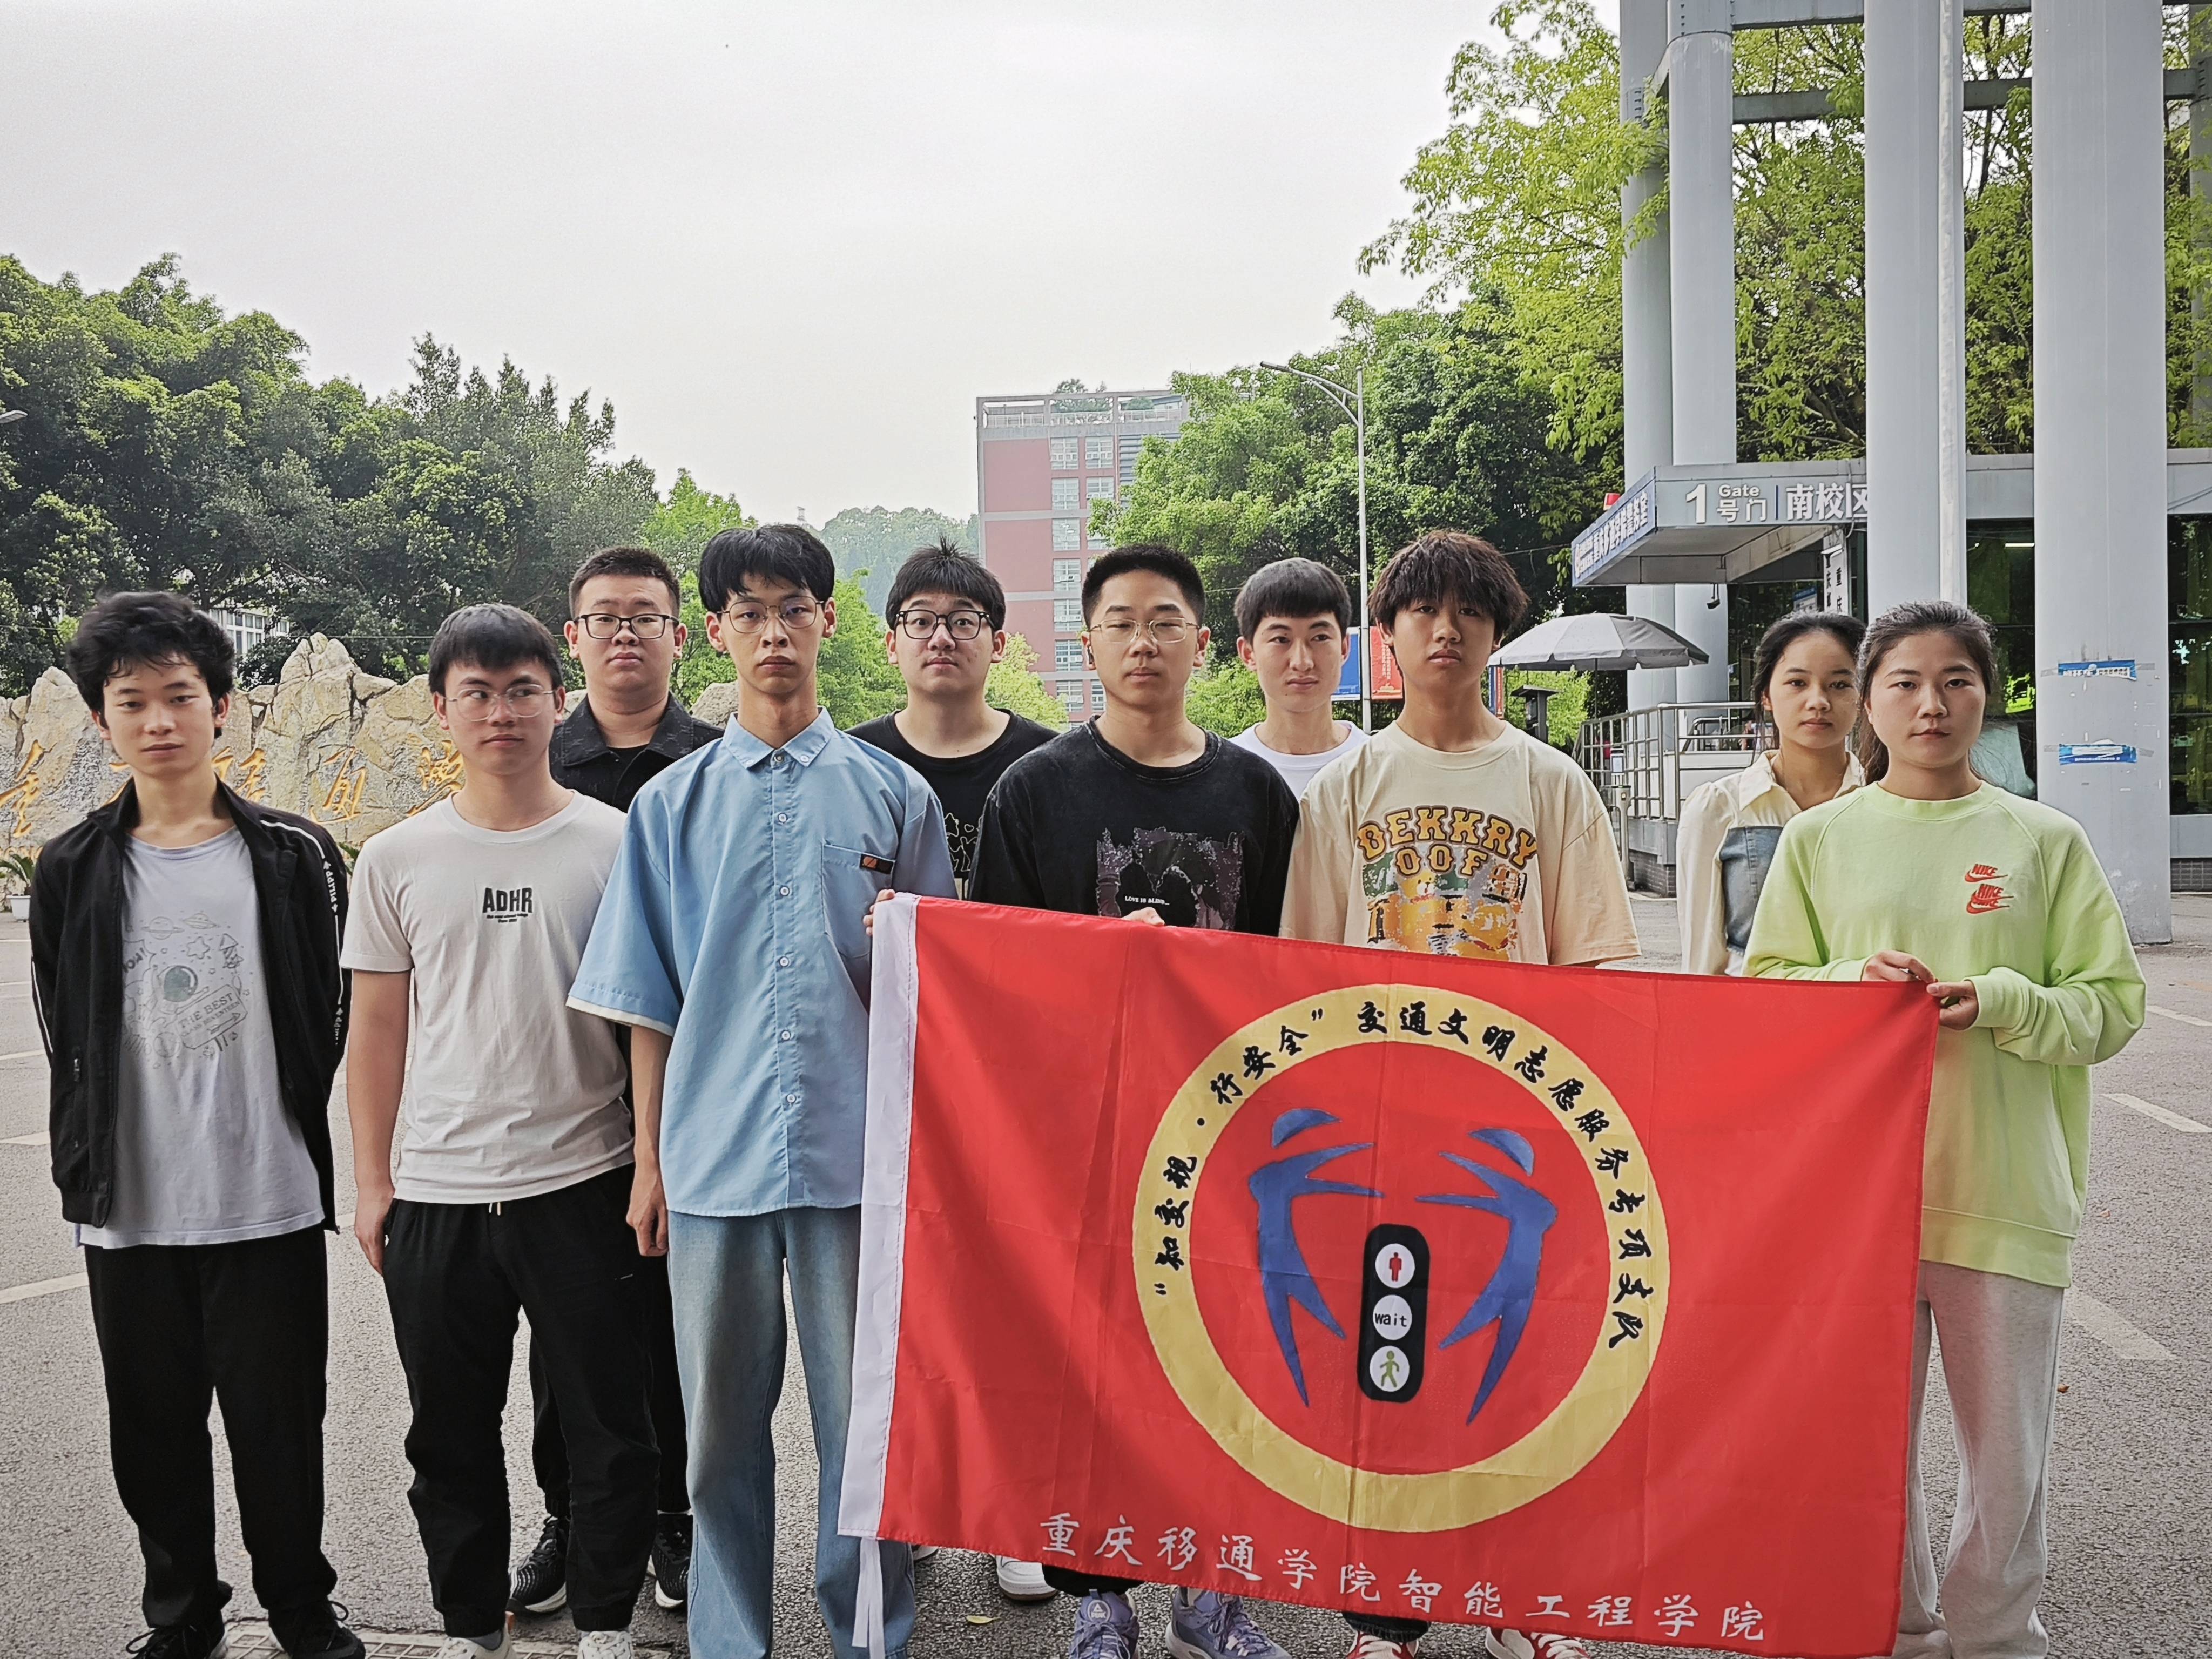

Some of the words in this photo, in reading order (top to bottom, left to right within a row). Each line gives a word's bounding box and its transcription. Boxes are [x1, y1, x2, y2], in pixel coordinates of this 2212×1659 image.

[1718, 484, 1759, 497] Gate
[1786, 482, 1868, 521] 南校区
[1395, 842, 1489, 878] OOF
[1972, 864, 1998, 876] NIKE
[482, 887, 532, 913] ADHR
[1977, 883, 2004, 898] NIKE
[178, 1011, 203, 1028] THE
[204, 993, 233, 1014] BEST
[1374, 1313, 1407, 1327] wait
[1040, 1512, 1764, 1641] 重庆移通学院智能工程学院
